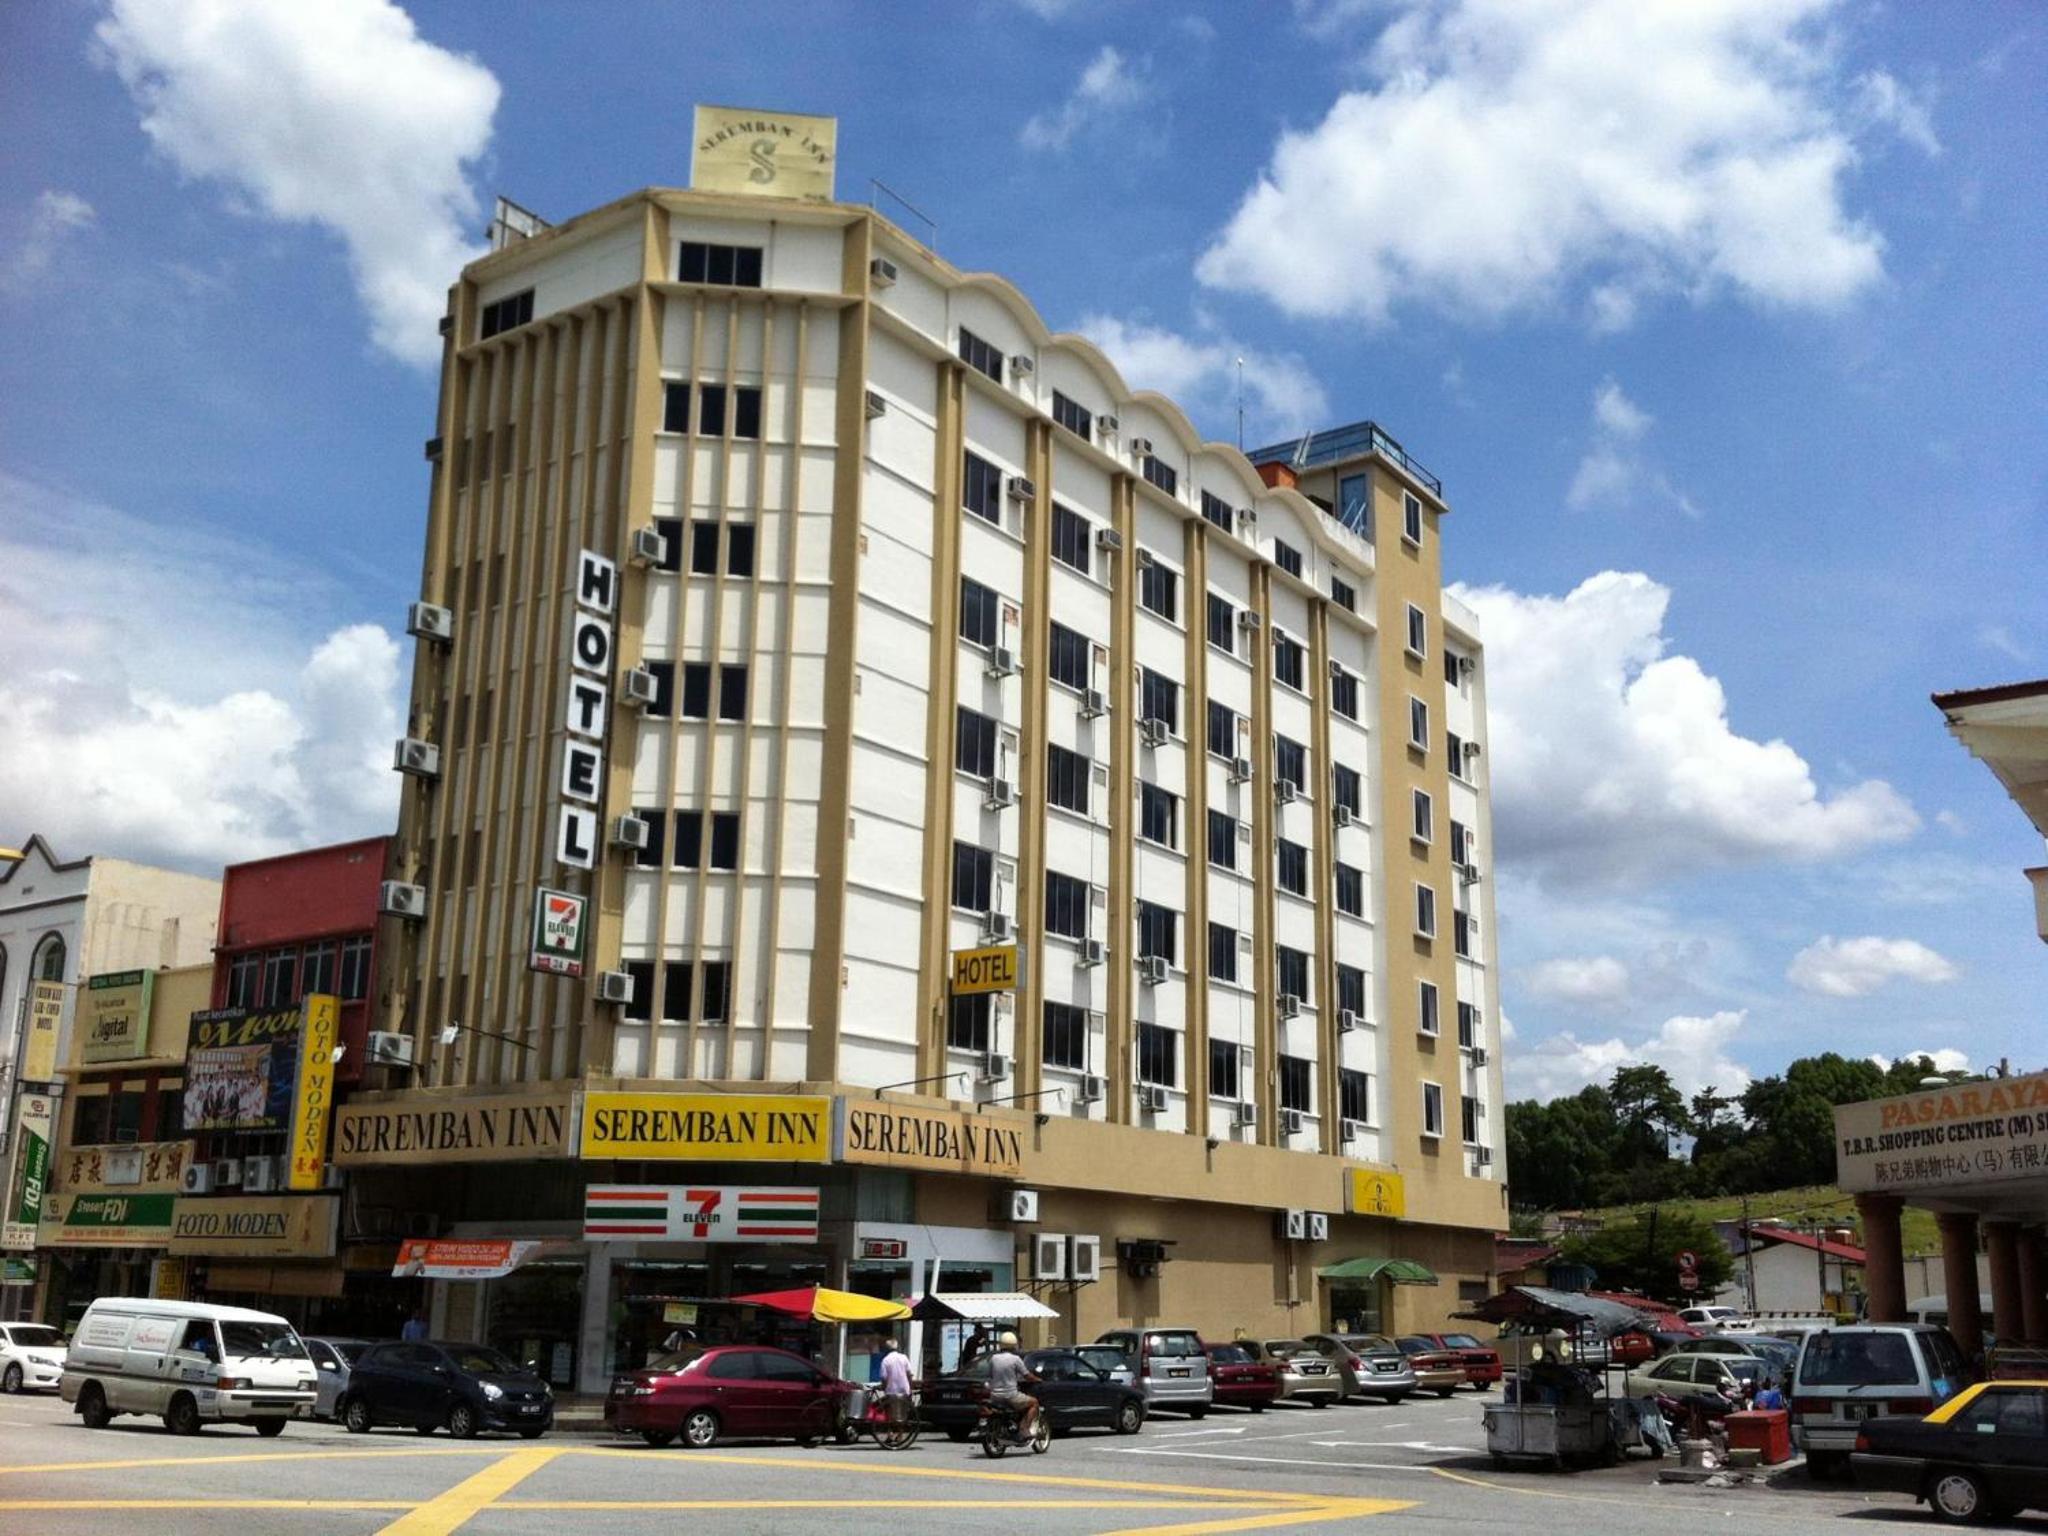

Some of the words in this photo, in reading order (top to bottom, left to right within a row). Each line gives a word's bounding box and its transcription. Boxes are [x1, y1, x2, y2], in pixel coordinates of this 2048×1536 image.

[700, 121, 793, 153] SEREMBAN
[566, 559, 611, 861] HOTEL
[956, 953, 1012, 986] HOTEL
[312, 1004, 331, 1065] FOTO
[302, 1074, 325, 1152] MODEN
[593, 1110, 758, 1143] SEREMBAN
[766, 1112, 819, 1144] INN
[1880, 1078, 2048, 1129] PASARAYA
[341, 1108, 498, 1153] SEREMBAN
[506, 1105, 566, 1147] INN
[850, 1110, 977, 1162] SEREMBAN
[984, 1127, 1022, 1166] INN
[1879, 1126, 1944, 1151] SHOPPING
[1947, 1118, 2005, 1142] CENTRE
[2008, 1114, 2034, 1138] (M)
[175, 1213, 219, 1235] FOTO
[222, 1213, 289, 1235] MODEN
[686, 1190, 721, 1237] 7
